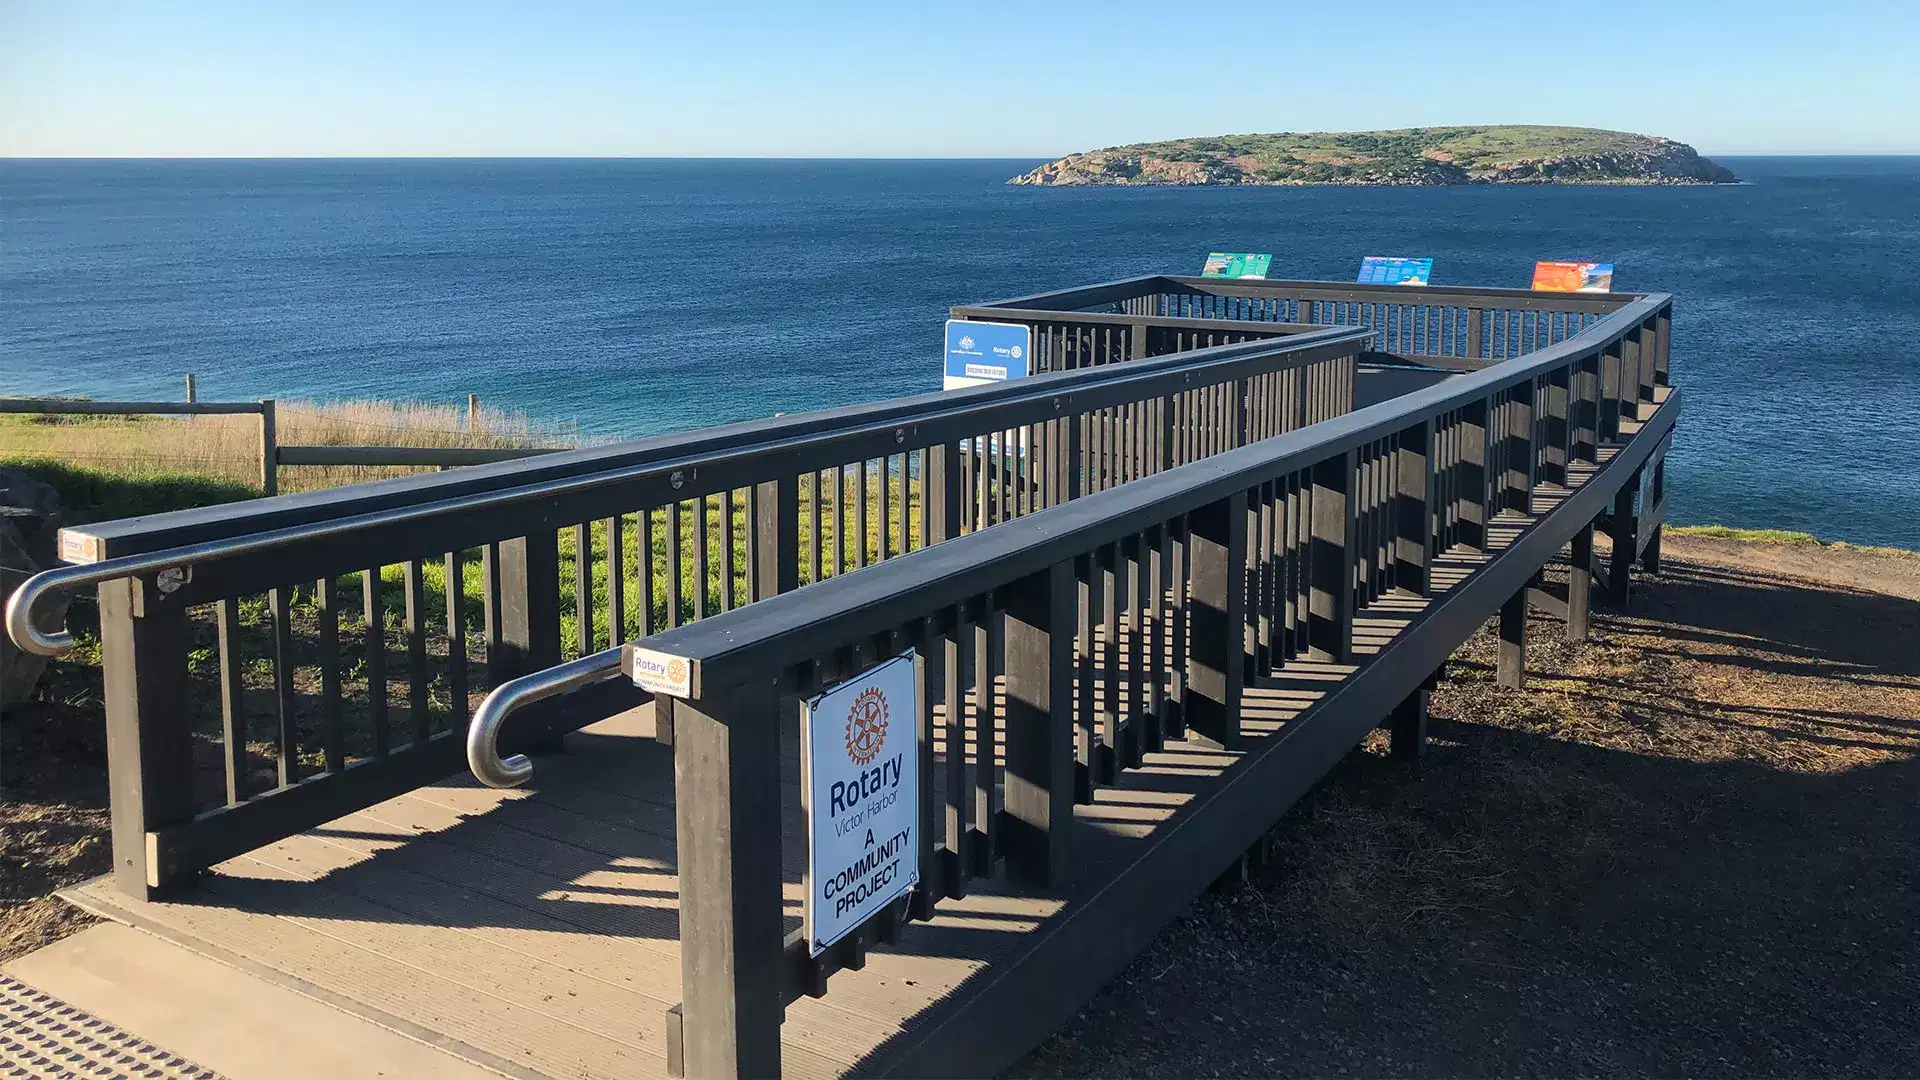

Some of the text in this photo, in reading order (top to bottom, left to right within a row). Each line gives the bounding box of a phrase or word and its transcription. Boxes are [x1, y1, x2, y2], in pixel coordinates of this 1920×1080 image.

[993, 346, 1010, 355] Rotary
[635, 657, 666, 675] Rotary
[830, 753, 903, 818] Rotary
[834, 789, 898, 837] Victor Harbor
[864, 828, 875, 849] A
[824, 826, 910, 900] COMMUNITY
[836, 859, 900, 919] PROJECT
